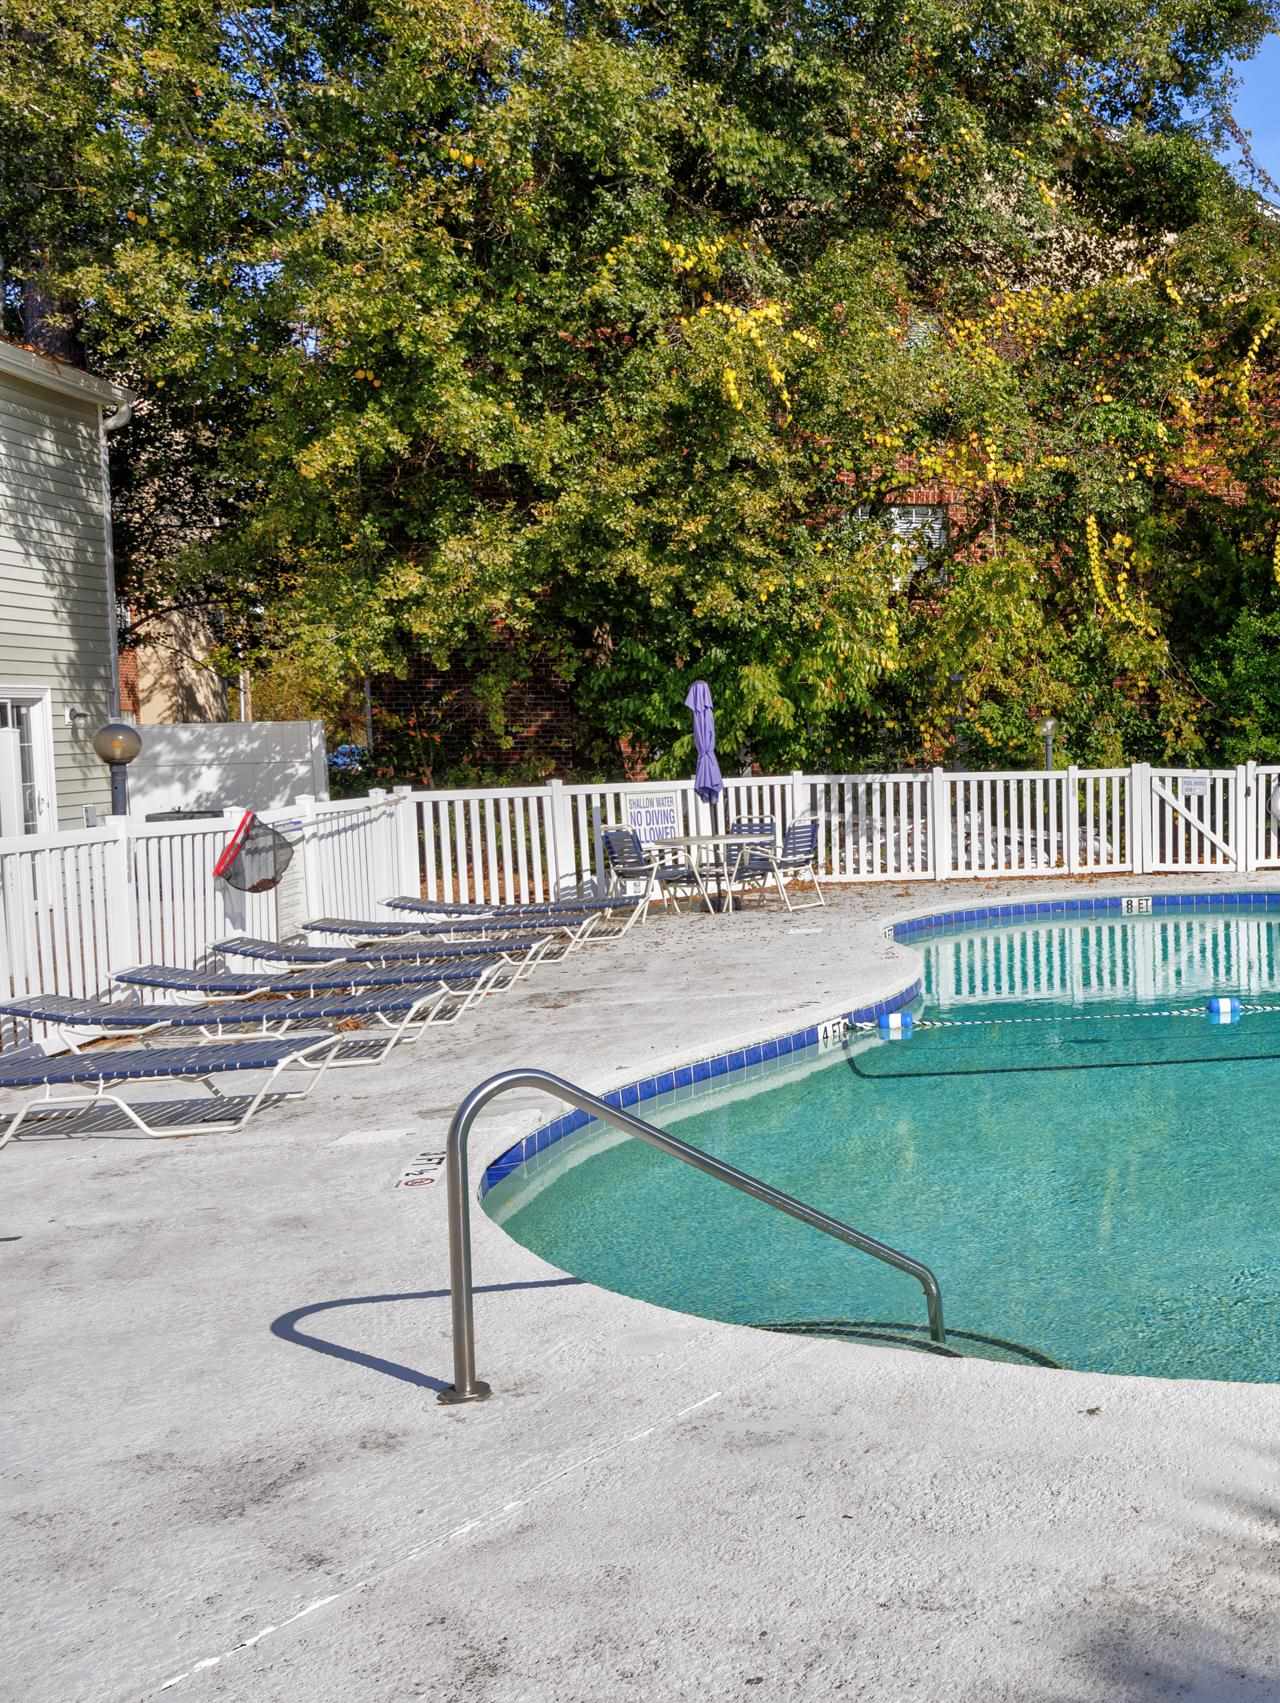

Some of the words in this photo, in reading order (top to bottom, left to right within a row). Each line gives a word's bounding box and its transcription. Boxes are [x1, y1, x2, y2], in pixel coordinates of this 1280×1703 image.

[629, 797, 654, 809] SHALLOW
[656, 796, 673, 808] WATER
[630, 810, 643, 827] NO
[645, 808, 676, 826] DIVING
[639, 826, 676, 843] LLOWED
[822, 1025, 829, 1041] 4
[832, 1021, 841, 1041] FT
